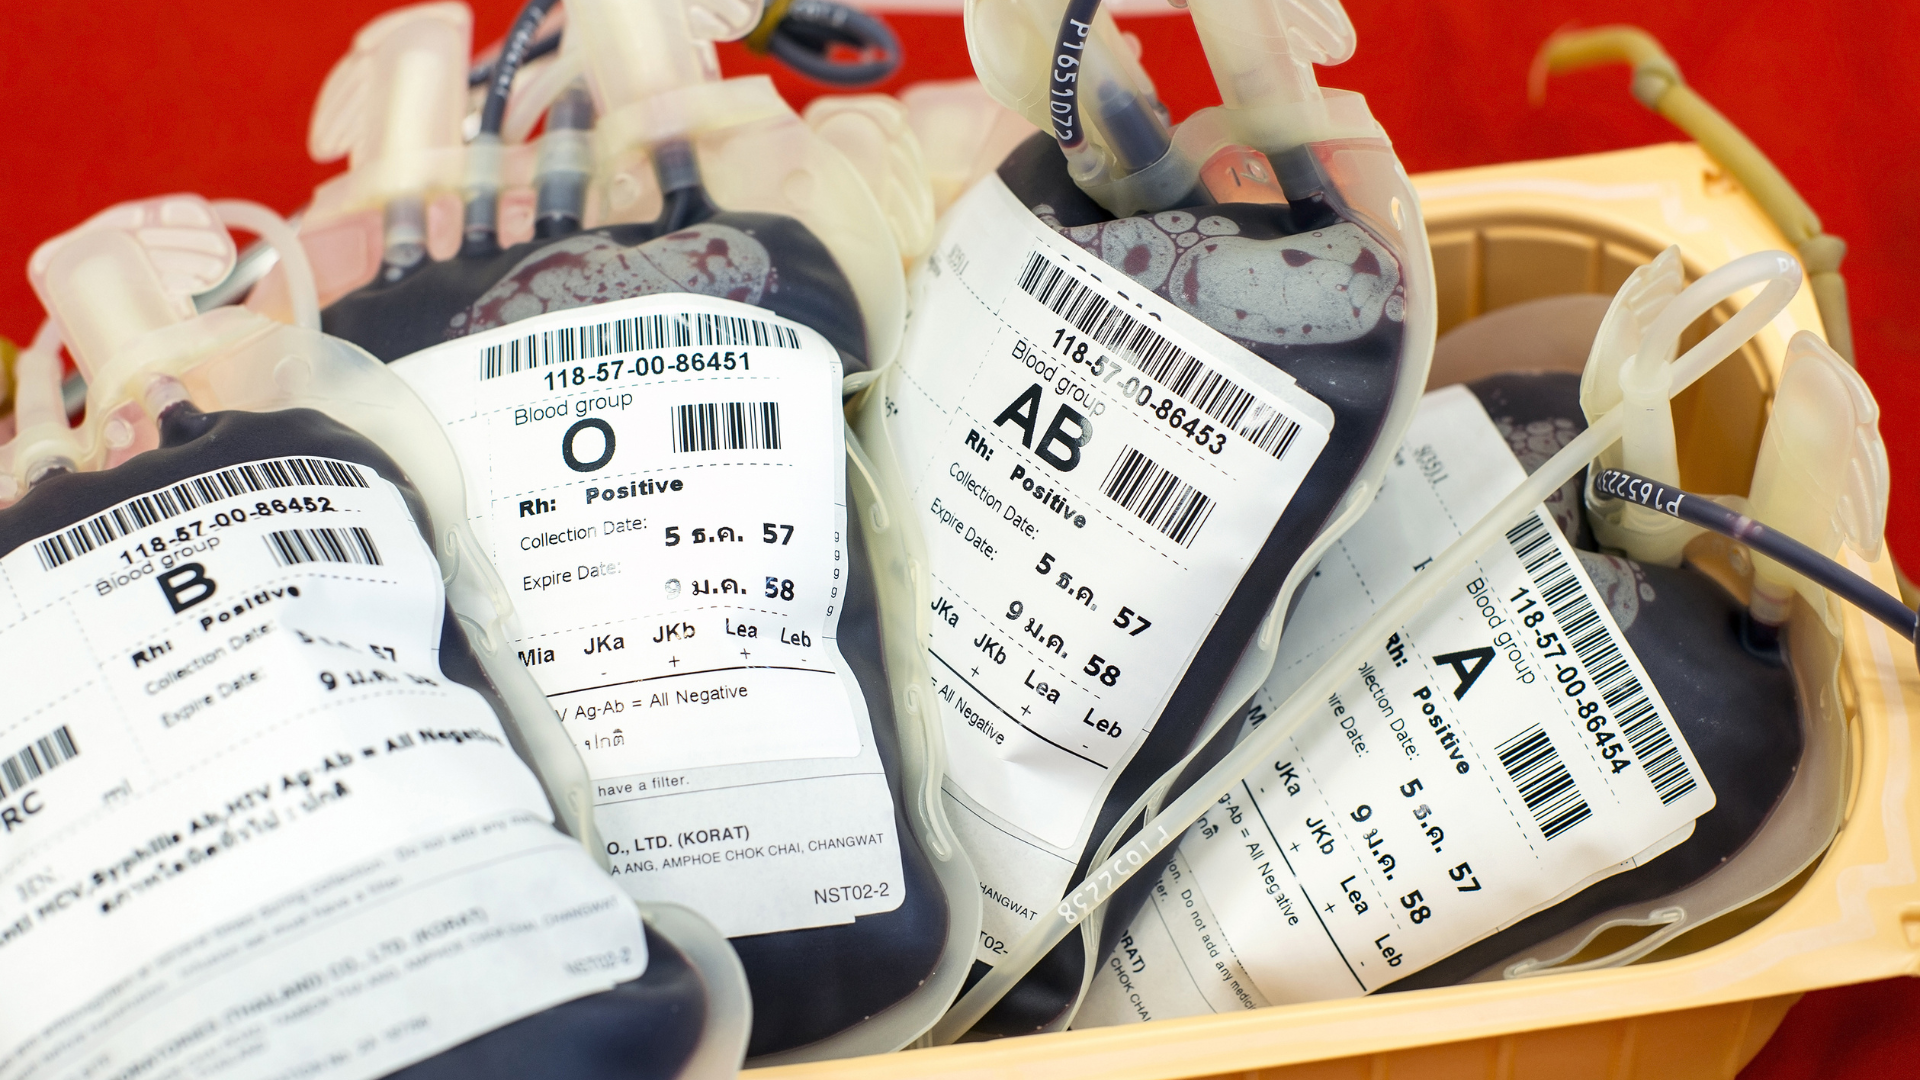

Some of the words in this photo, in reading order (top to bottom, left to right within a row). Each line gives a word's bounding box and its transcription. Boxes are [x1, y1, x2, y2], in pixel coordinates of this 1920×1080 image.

[1050, 18, 1091, 142] P1651072
[545, 352, 751, 391] 118-57-00-86451
[1011, 339, 1058, 383] Blood
[1056, 375, 1107, 417] group
[1051, 327, 1227, 456] 118-57-00-86453
[514, 400, 569, 426] Blood
[575, 392, 633, 418] group
[993, 382, 1095, 474] AB
[561, 417, 616, 473] O
[519, 498, 557, 518] Rh:
[585, 477, 684, 504] Positive
[948, 461, 1003, 511] Collection
[1002, 503, 1040, 541] Date:
[964, 428, 995, 461] Rh:
[1009, 464, 1087, 529] Positive
[120, 496, 333, 566] 118-57-00-86452
[520, 525, 598, 552] Collection
[603, 515, 648, 536] Date:
[664, 526, 680, 547] 5
[691, 525, 744, 545] ธ.ค.
[763, 522, 795, 546] 57
[930, 497, 963, 535] Expire
[964, 526, 999, 561] Date:
[96, 561, 155, 596] Blood
[161, 537, 221, 571] group
[156, 562, 218, 614] B
[523, 568, 573, 592] Expire
[577, 560, 622, 581] Date:
[664, 577, 681, 600] 9
[764, 576, 795, 601] 58
[1035, 552, 1056, 576] 5
[1112, 605, 1152, 638] 57
[131, 640, 173, 668] Rh:
[200, 585, 301, 632] Positive
[518, 647, 556, 667] Mia
[584, 634, 625, 655] JKa
[653, 621, 696, 643] JKb
[725, 618, 758, 639] Lea
[780, 627, 812, 648] Leb
[1005, 599, 1025, 622] 9
[1082, 653, 1122, 688] 58
[1466, 576, 1504, 629] Blood
[1493, 630, 1536, 686] group
[145, 648, 226, 697] Collection
[229, 622, 276, 651] Date:
[930, 596, 960, 628] JKa
[973, 633, 1007, 666] JKb
[1023, 668, 1061, 705] Lea
[1082, 707, 1123, 740] Leb
[1432, 645, 1496, 701] A
[1510, 586, 1632, 776] 118-57-00-86454
[161, 693, 213, 729] Expire
[217, 667, 265, 699] Date:
[575, 699, 625, 721] Ag-Ab
[650, 691, 670, 709] All
[676, 684, 748, 706] Negative
[938, 684, 955, 704] All
[954, 698, 1006, 745] Negative
[1358, 662, 1395, 719] ollection
[1389, 717, 1420, 762] Date:
[1384, 631, 1409, 669] Rh:
[1413, 685, 1470, 775] Positive
[386, 732, 413, 753] All
[420, 728, 503, 747] Negativ
[1340, 715, 1370, 758] Date:
[598, 781, 633, 798] have
[638, 781, 647, 792] a
[652, 775, 690, 789] filter.
[607, 840, 629, 856] O.,
[634, 835, 672, 853] LTD.
[678, 824, 751, 848] (KORAT)
[624, 859, 659, 874] ANG,
[661, 851, 722, 870] AMPHOE
[724, 846, 765, 862] CHOK
[768, 841, 805, 857] CHAI,
[808, 832, 885, 852] CHANGWAT
[1219, 792, 1243, 826] g-Ab
[1245, 841, 1266, 862] All
[1257, 858, 1300, 927] Negative
[1274, 759, 1301, 798] JKa
[1306, 816, 1337, 855] JKb
[1339, 875, 1370, 916] Lea
[1374, 934, 1403, 969] Leb
[1350, 804, 1373, 824] 9
[1399, 889, 1432, 925] 58
[1399, 778, 1424, 798] 5
[1449, 861, 1482, 893] 57
[813, 882, 890, 905] NST02-2
[979, 882, 1038, 921] HANGWAT
[1057, 825, 1171, 925] P1652238
[1180, 888, 1194, 909] Do
[1190, 910, 1207, 933] not
[1200, 934, 1218, 959] add
[1215, 960, 1233, 982] any
[1110, 956, 1135, 995] CHOK
